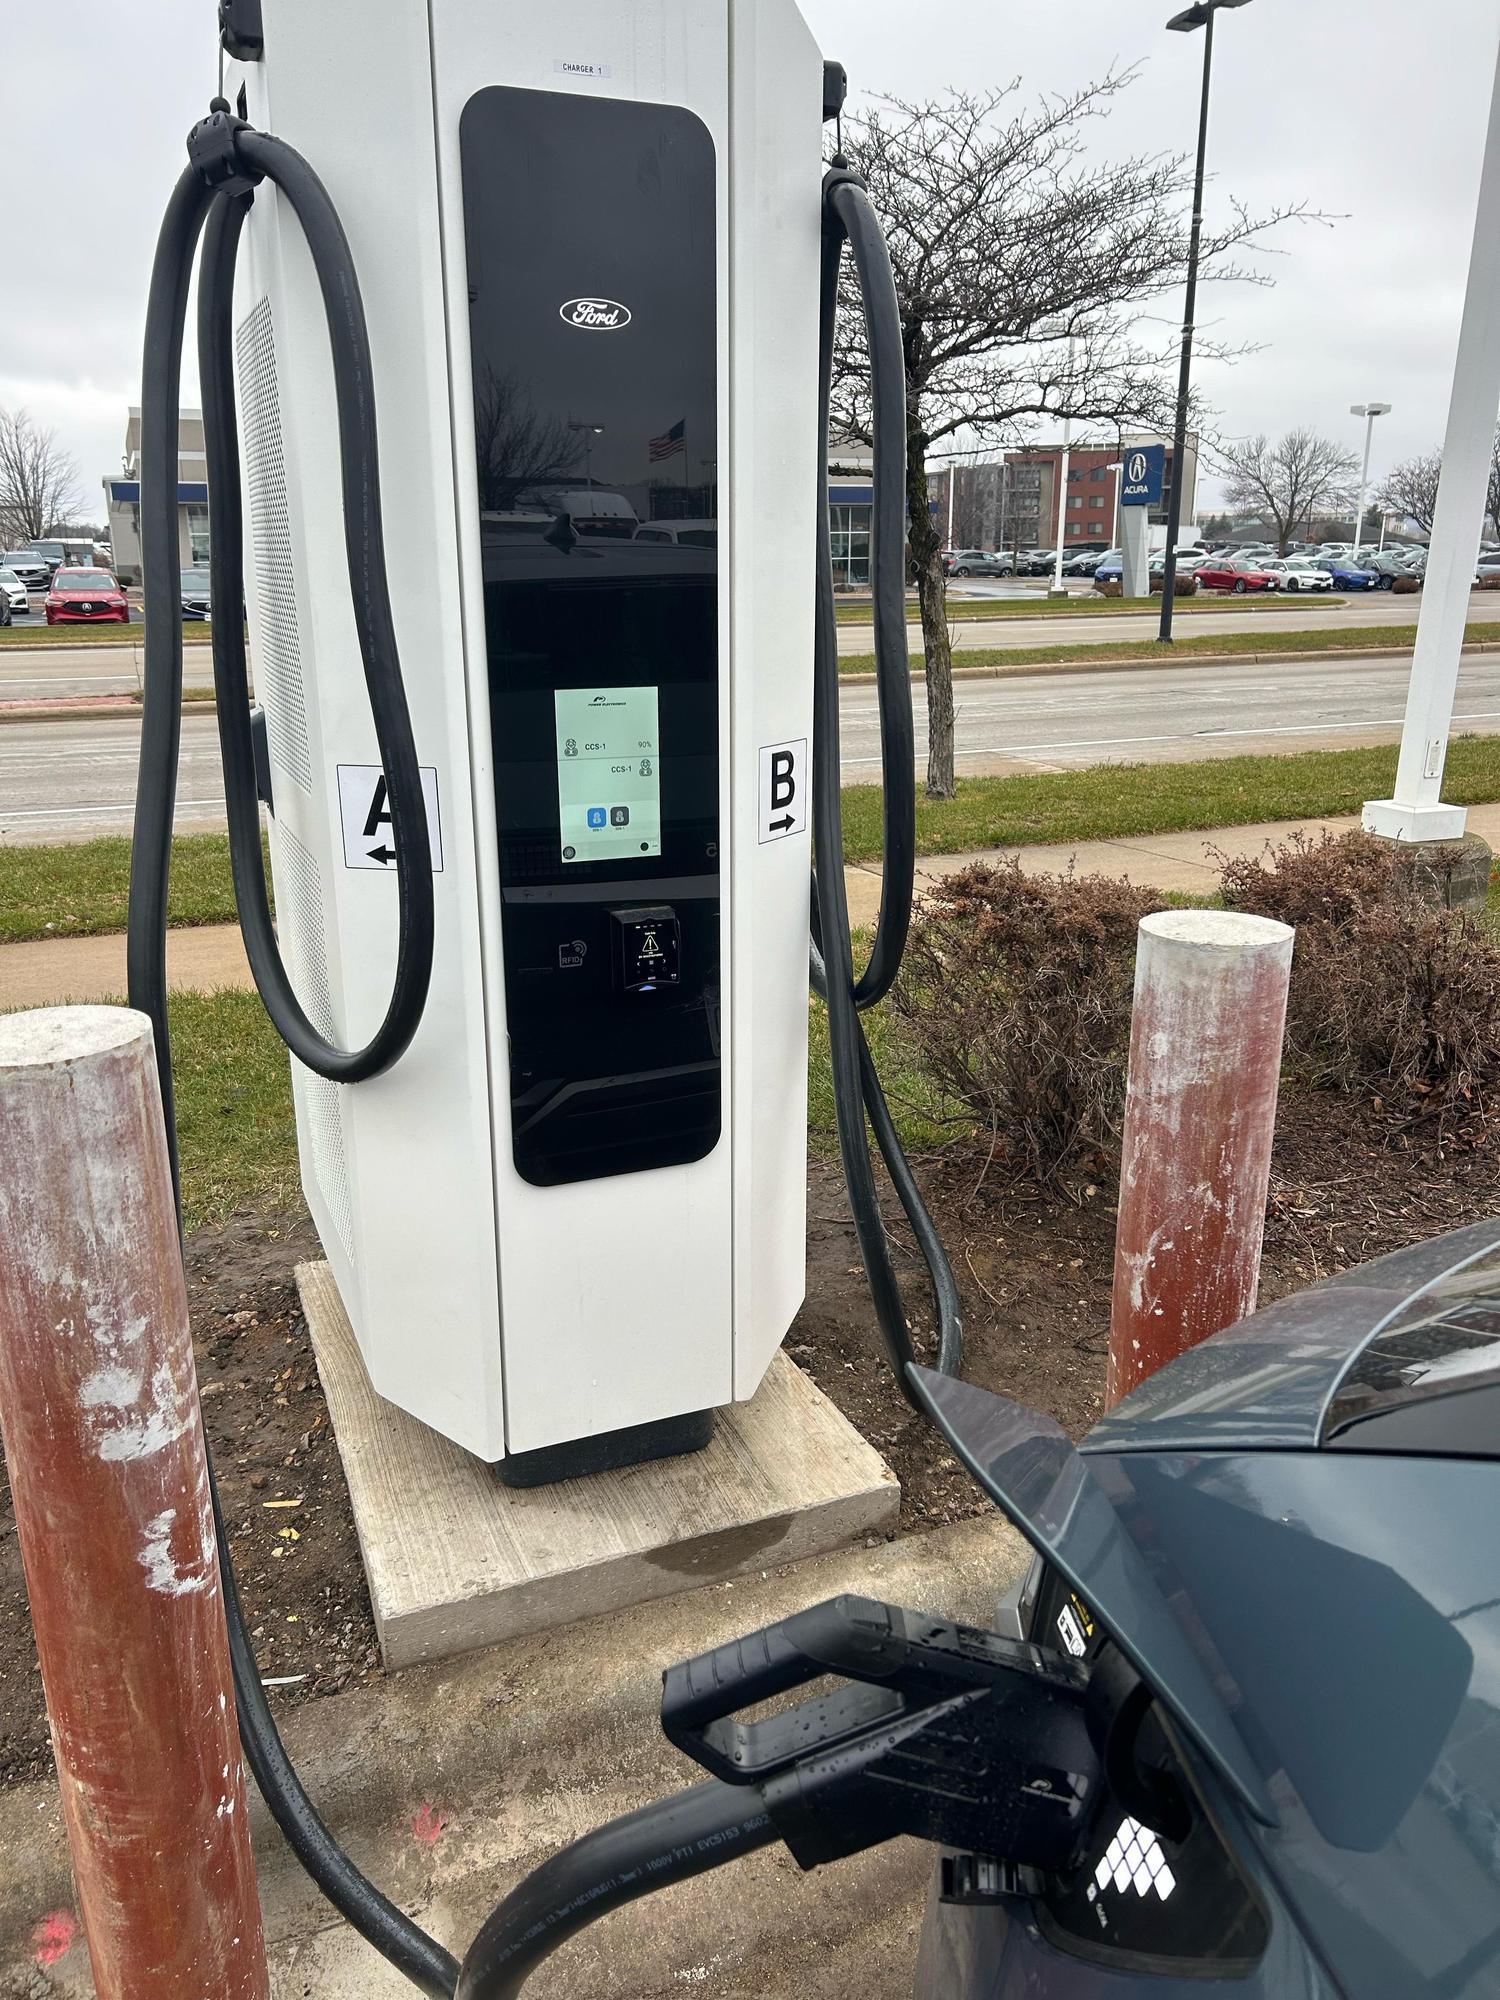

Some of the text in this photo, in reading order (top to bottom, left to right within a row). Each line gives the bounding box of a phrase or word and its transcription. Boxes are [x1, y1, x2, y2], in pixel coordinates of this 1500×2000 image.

[562, 62, 594, 74] CHARGER
[572, 301, 619, 326] Ford
[1124, 485, 1148, 494] ACURA
[585, 742, 606, 751] CCS-1
[611, 765, 632, 774] CCS-1
[771, 750, 795, 811] B
[561, 956, 580, 965] RFID
